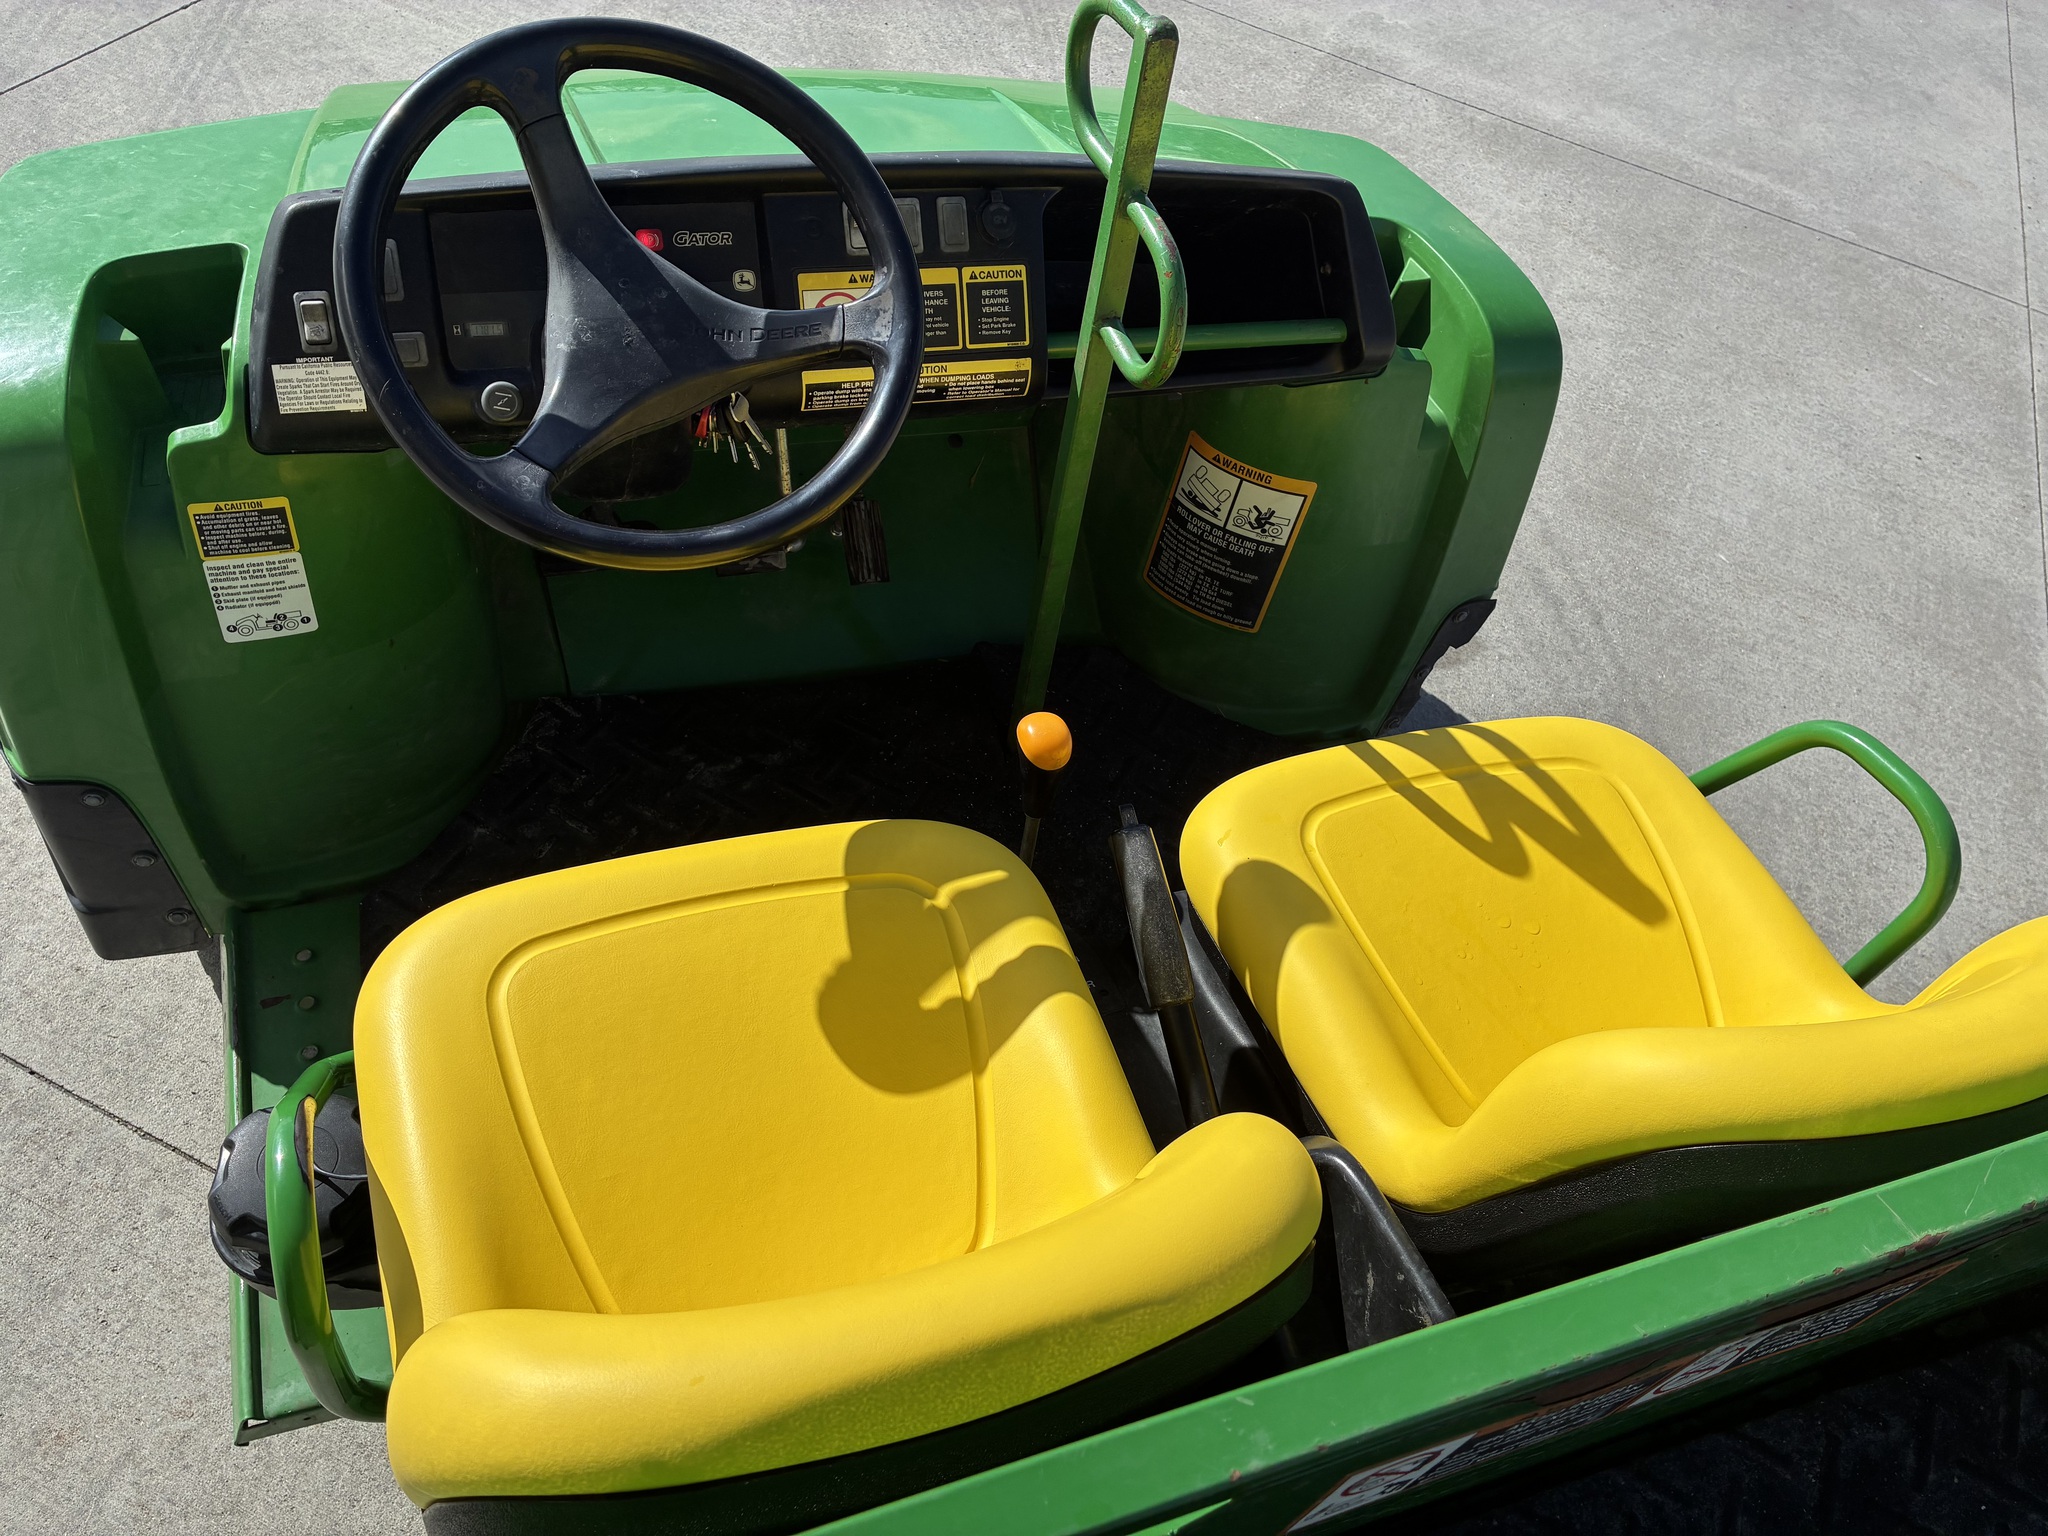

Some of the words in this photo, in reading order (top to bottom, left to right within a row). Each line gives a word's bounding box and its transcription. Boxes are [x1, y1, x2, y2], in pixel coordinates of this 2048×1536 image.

[979, 270, 1022, 279] CAUTION
[750, 322, 822, 342] DEERE
[921, 365, 947, 374] TION
[1222, 457, 1272, 484] WARNING
[224, 501, 263, 510] CAUTION
[1177, 506, 1211, 533] ROLLOVER
[1213, 527, 1224, 539] OR
[1224, 531, 1257, 550] FALLING
[1259, 543, 1274, 554] OFF
[1186, 522, 1202, 536] MAY
[1203, 533, 1228, 548] CAUSE
[1228, 542, 1254, 557] DEATH
[266, 564, 289, 572] special
